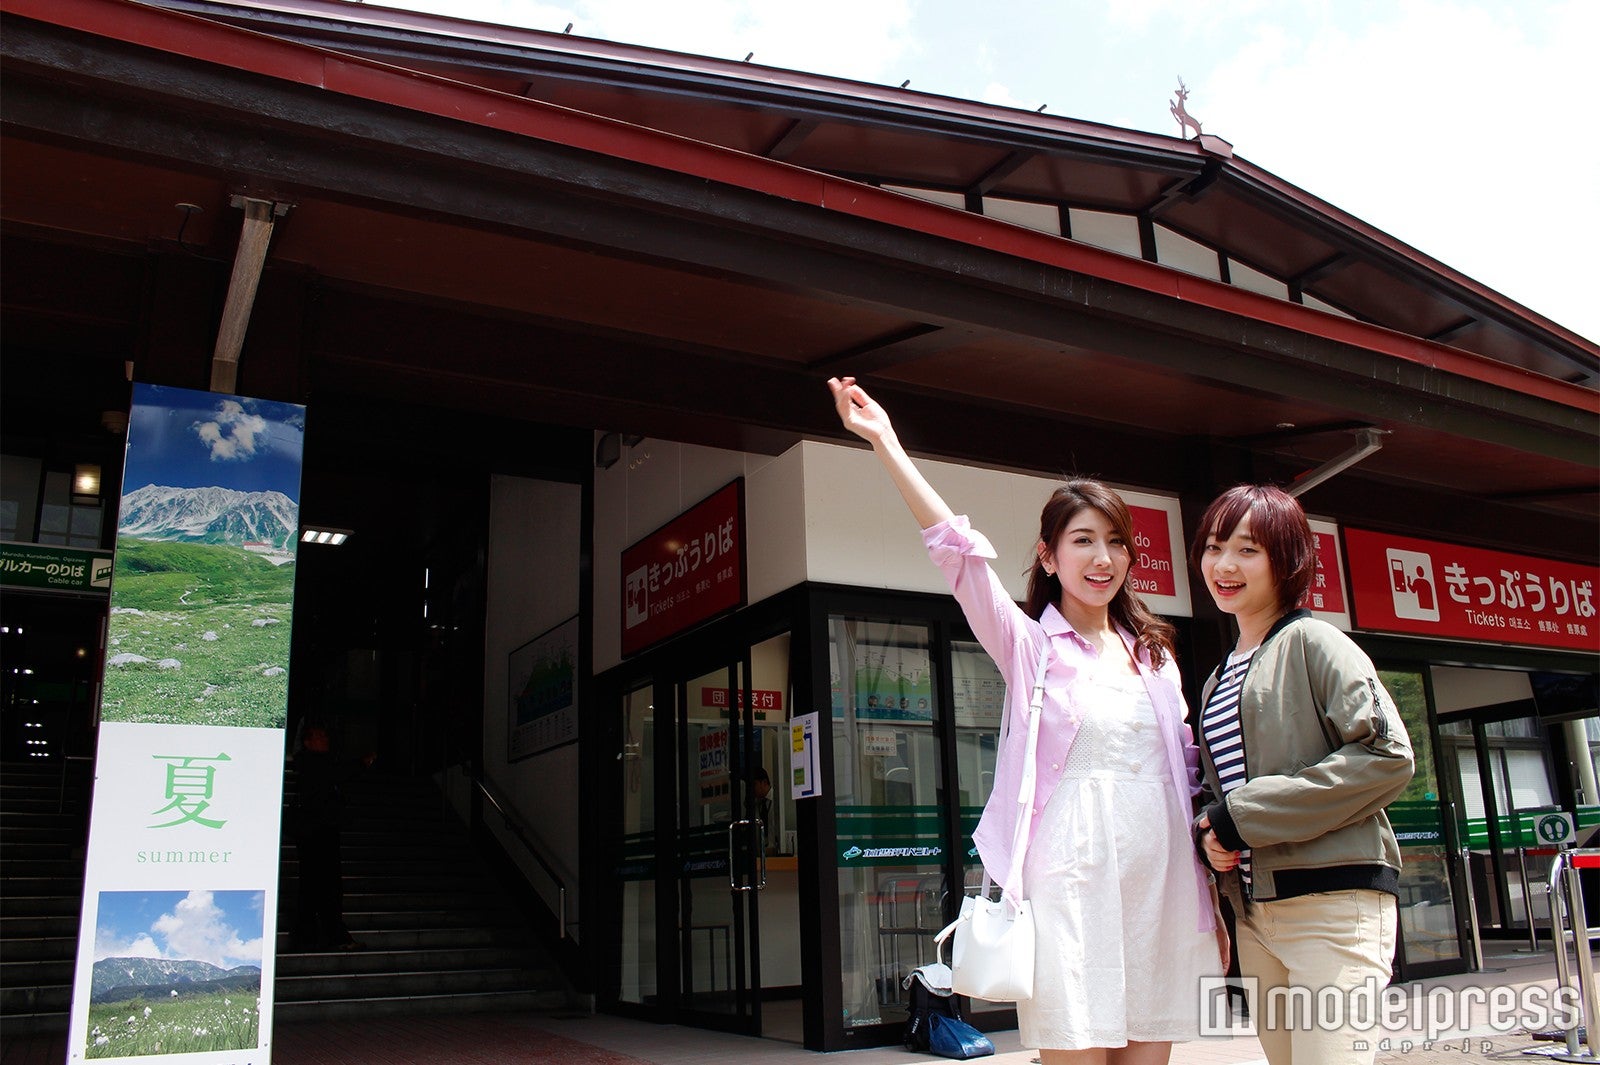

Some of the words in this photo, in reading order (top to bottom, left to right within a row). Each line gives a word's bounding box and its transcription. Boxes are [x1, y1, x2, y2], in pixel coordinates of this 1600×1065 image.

[1134, 531, 1151, 548] do
[648, 516, 734, 593] きっぷうりば
[1137, 552, 1170, 571] -Dam
[48, 577, 69, 585] Cable
[1132, 578, 1158, 592] awa
[1443, 562, 1597, 618] きっぷうりば
[649, 596, 674, 617] Tickets
[1464, 609, 1506, 628] Tickets
[146, 752, 232, 829] 夏
[137, 850, 232, 863] summer
